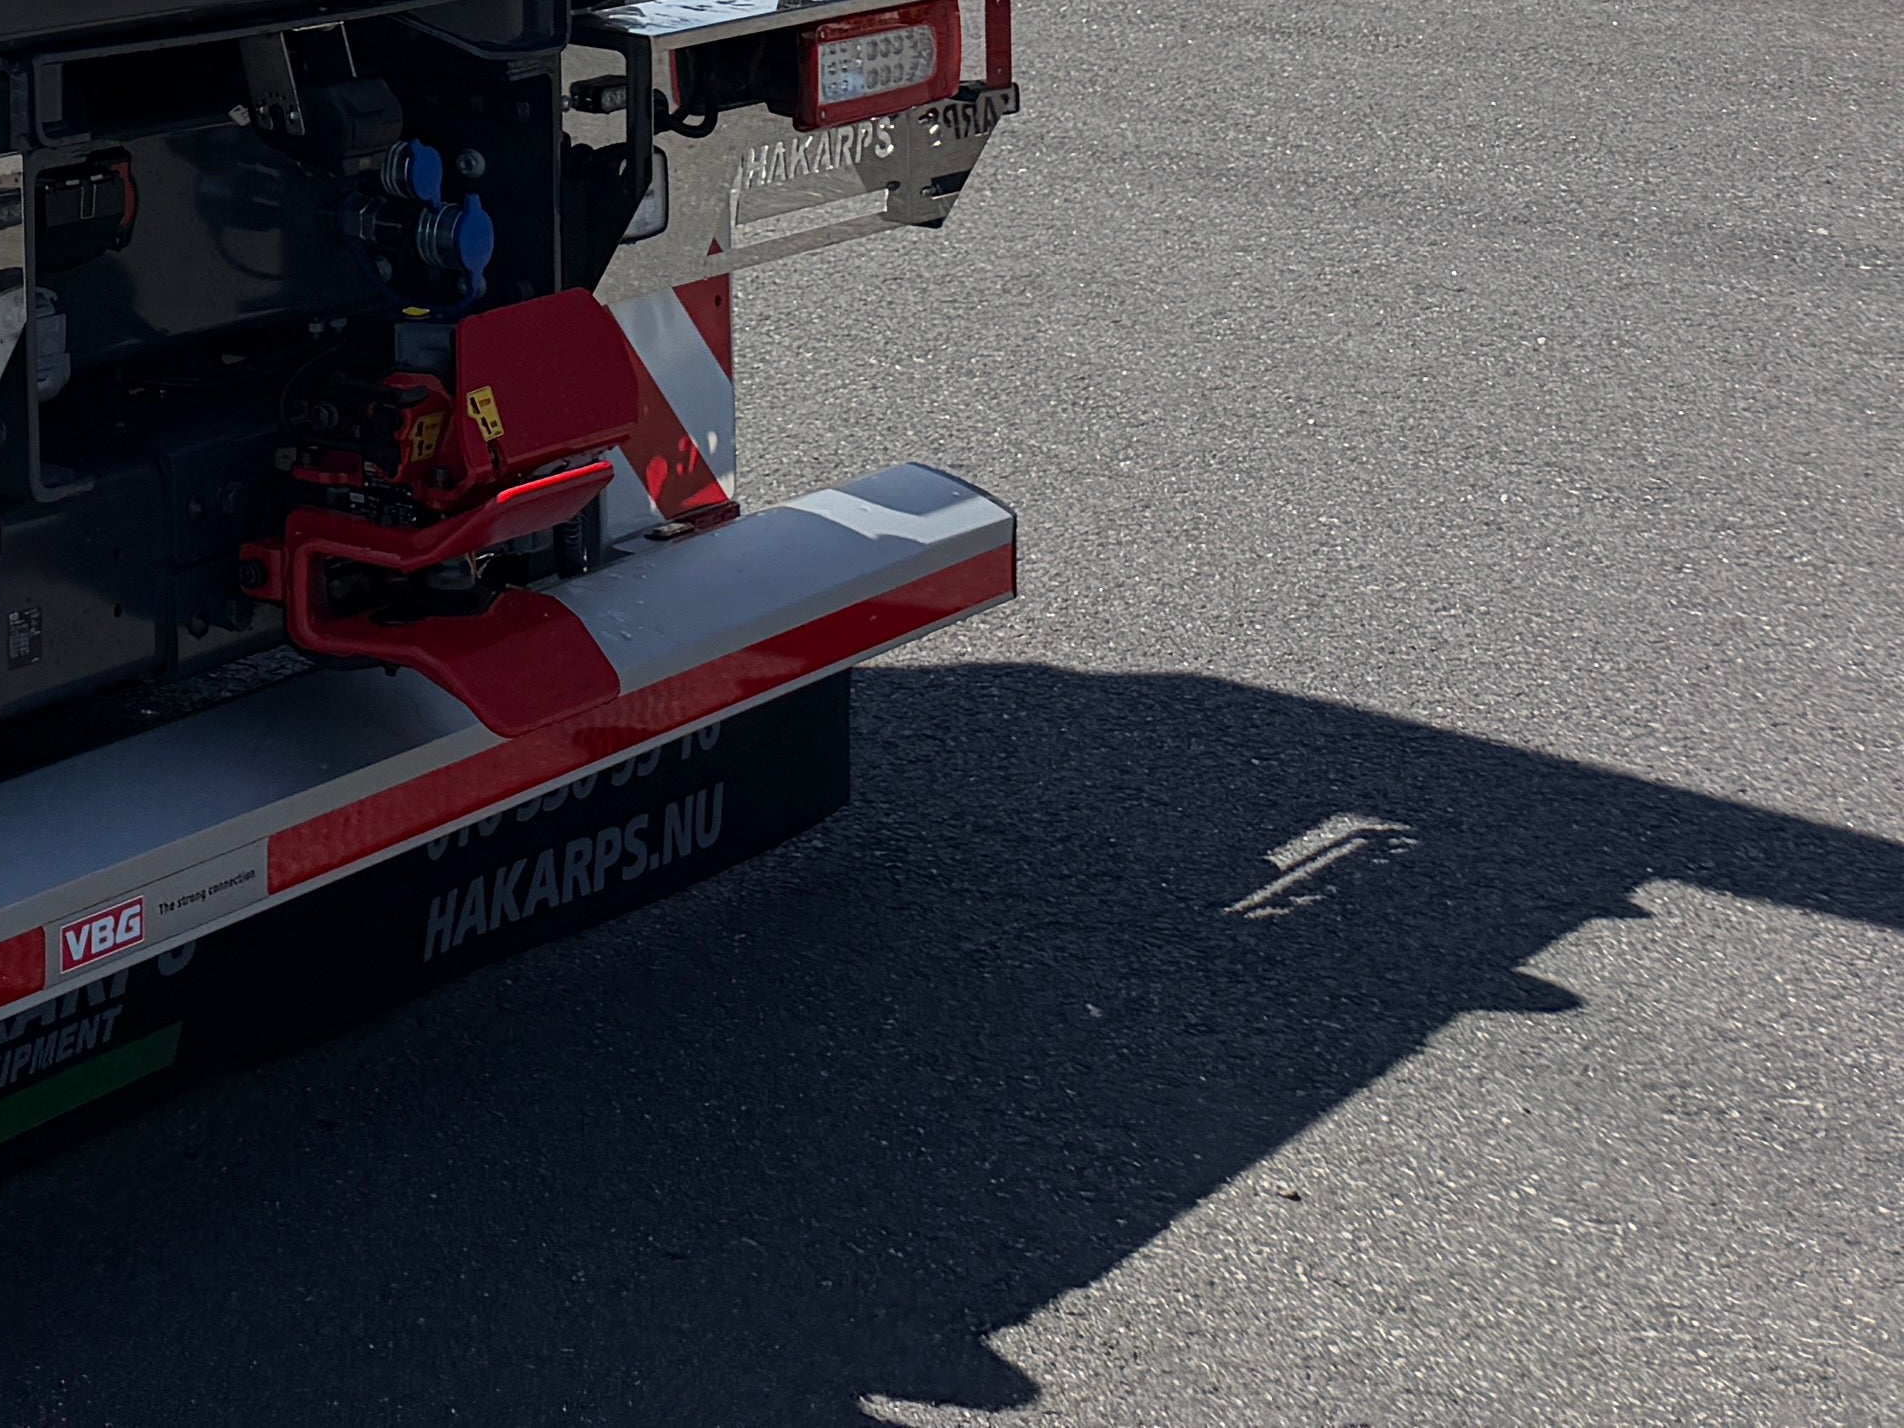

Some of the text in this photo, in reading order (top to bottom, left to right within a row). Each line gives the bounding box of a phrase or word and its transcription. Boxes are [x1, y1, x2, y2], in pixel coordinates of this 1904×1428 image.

[742, 114, 896, 191] HAKARPS
[158, 868, 257, 916] The strong connection
[423, 780, 725, 963] HAKARPS.NU
[65, 903, 142, 962] VBG
